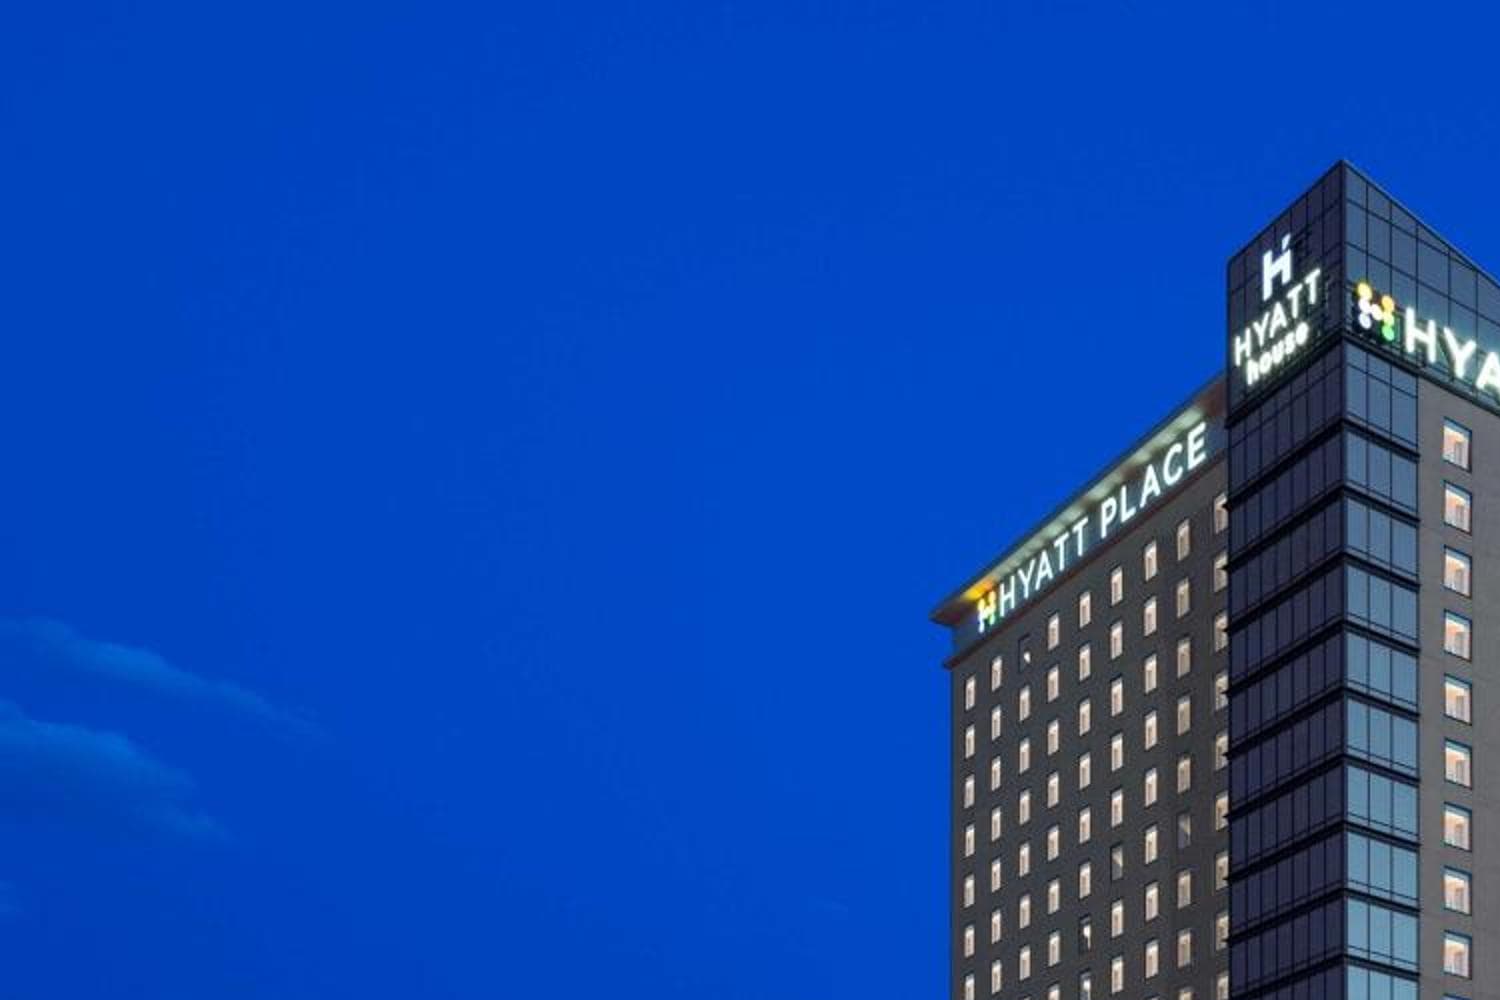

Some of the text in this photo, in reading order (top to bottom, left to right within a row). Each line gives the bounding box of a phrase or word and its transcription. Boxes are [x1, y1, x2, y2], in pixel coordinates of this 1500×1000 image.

[1234, 268, 1321, 366] HYATT
[999, 517, 1089, 617] HYATT
[1100, 422, 1207, 540] PLACE
